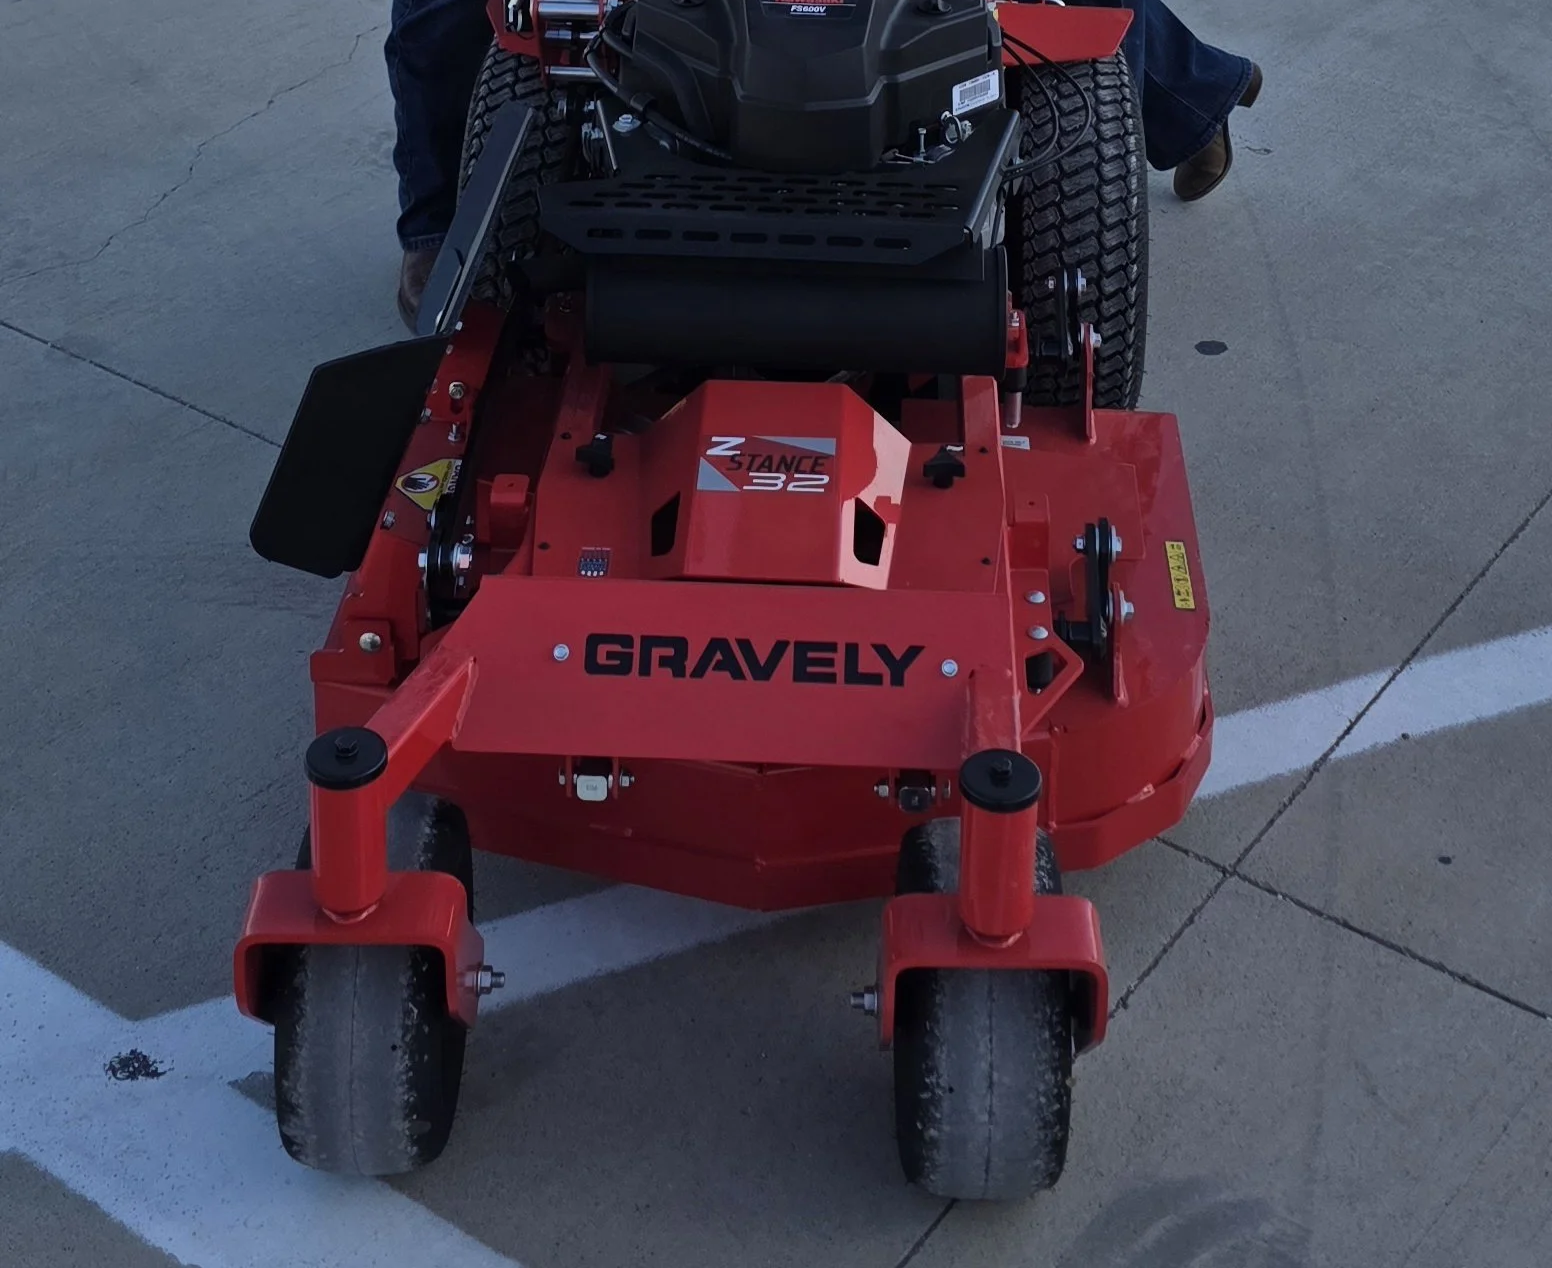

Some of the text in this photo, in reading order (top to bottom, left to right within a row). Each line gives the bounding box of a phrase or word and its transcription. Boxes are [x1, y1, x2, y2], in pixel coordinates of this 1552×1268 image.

[790, 5, 827, 13] FS600V
[707, 436, 746, 456] Z
[725, 453, 828, 473] STANCE
[742, 473, 830, 492] 32
[584, 633, 926, 687] GRAVELY
